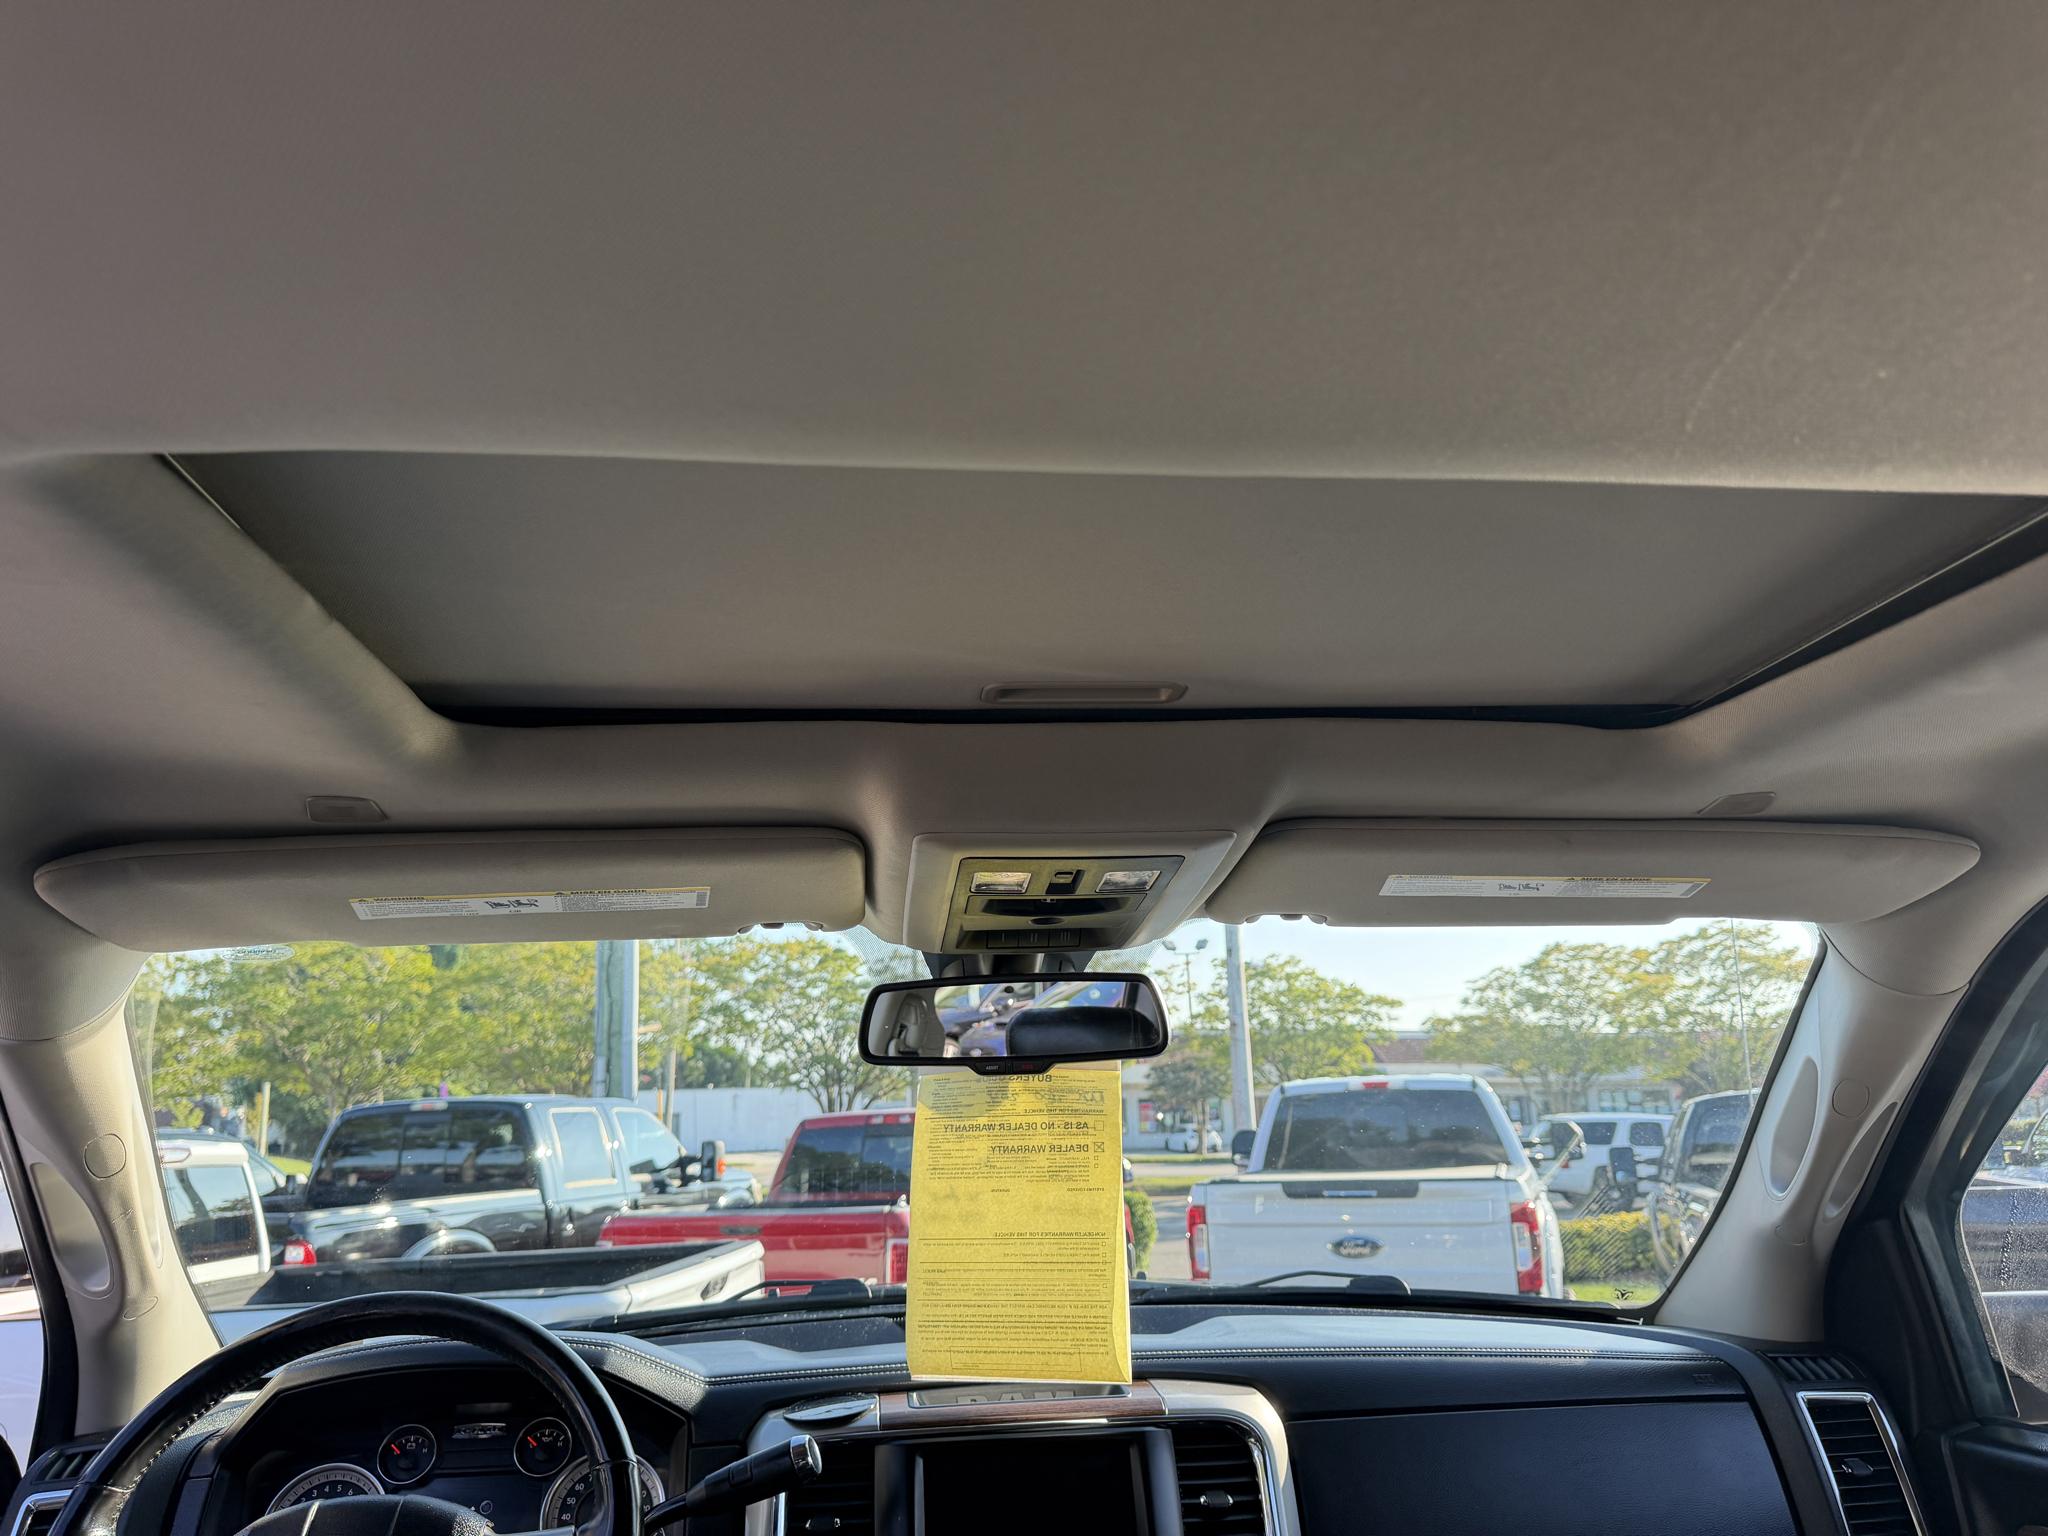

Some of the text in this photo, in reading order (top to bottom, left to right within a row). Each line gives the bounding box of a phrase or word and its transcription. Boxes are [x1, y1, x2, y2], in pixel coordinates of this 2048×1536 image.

[323, 1485, 330, 1493] 4
[336, 1484, 343, 1492] 5
[574, 1483, 584, 1491] 60
[311, 1489, 318, 1497] 3
[347, 1488, 354, 1496] 6
[566, 1496, 576, 1505] 50
[560, 1513, 571, 1521] 40
